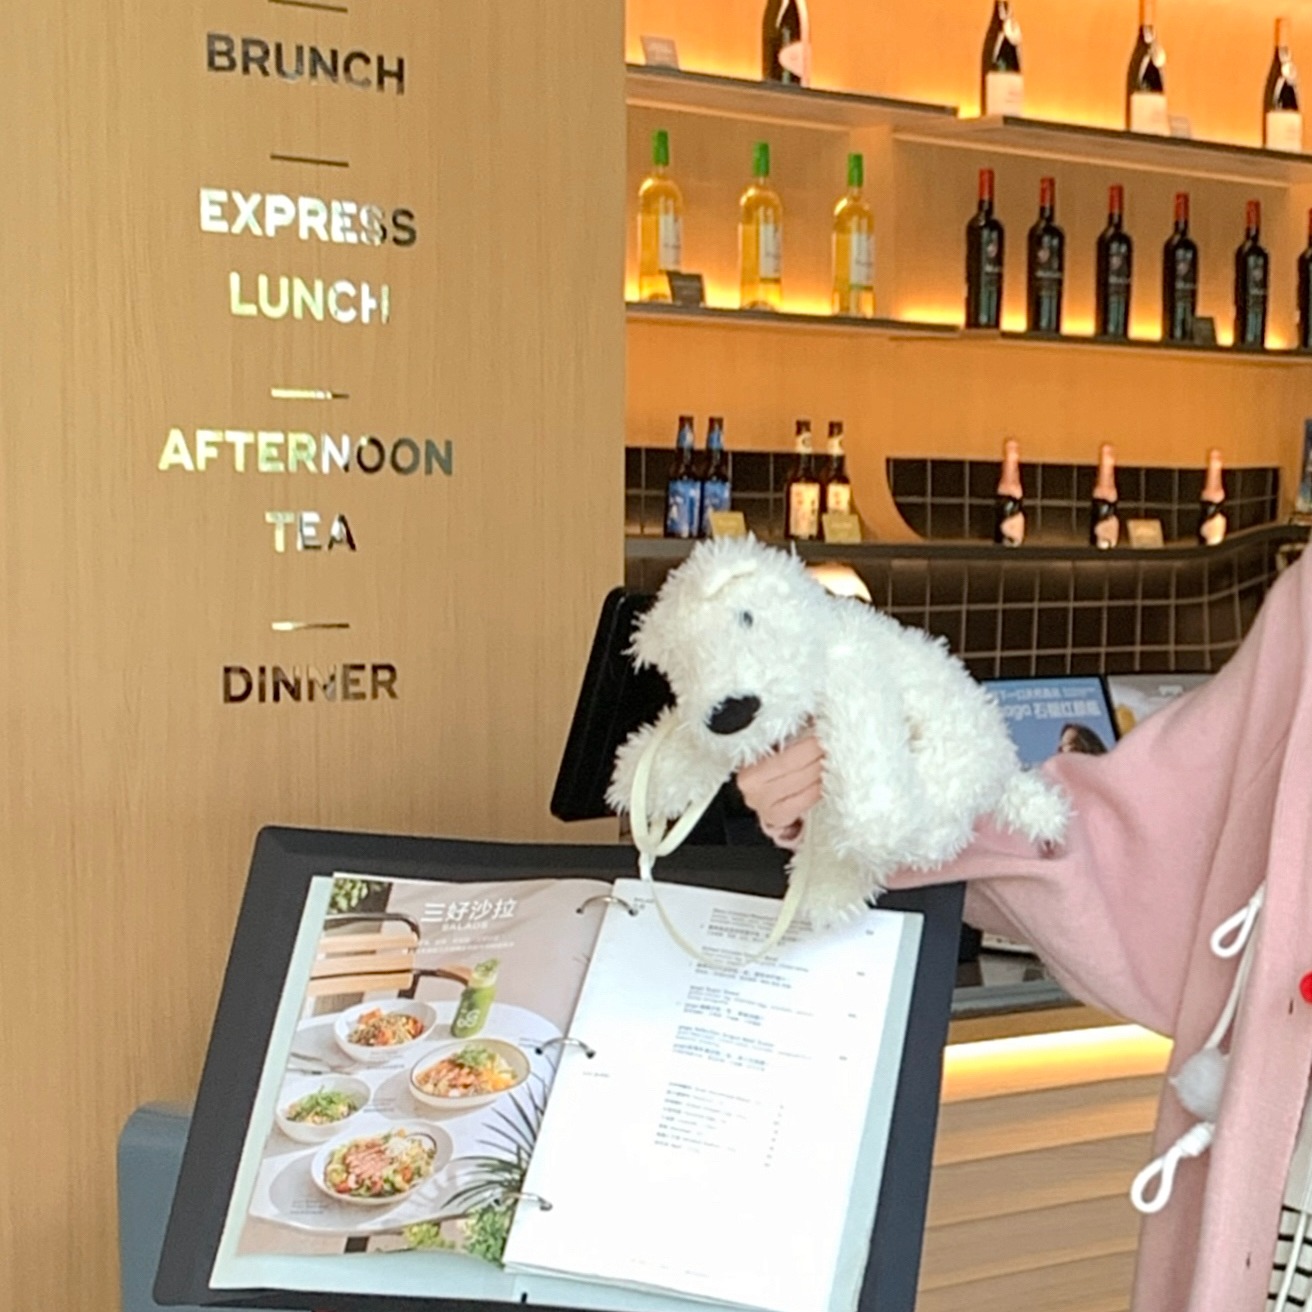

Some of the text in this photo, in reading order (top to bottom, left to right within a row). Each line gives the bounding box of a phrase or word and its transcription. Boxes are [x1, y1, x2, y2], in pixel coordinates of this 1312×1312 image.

[206, 31, 406, 95] BRUNCH
[199, 187, 418, 248] EXPRESS
[229, 271, 390, 325] LUNCH
[158, 428, 454, 476] AFTERNOON
[265, 511, 357, 553] TEA
[222, 663, 399, 705] DINNER
[420, 897, 518, 922] 三好沙拉
